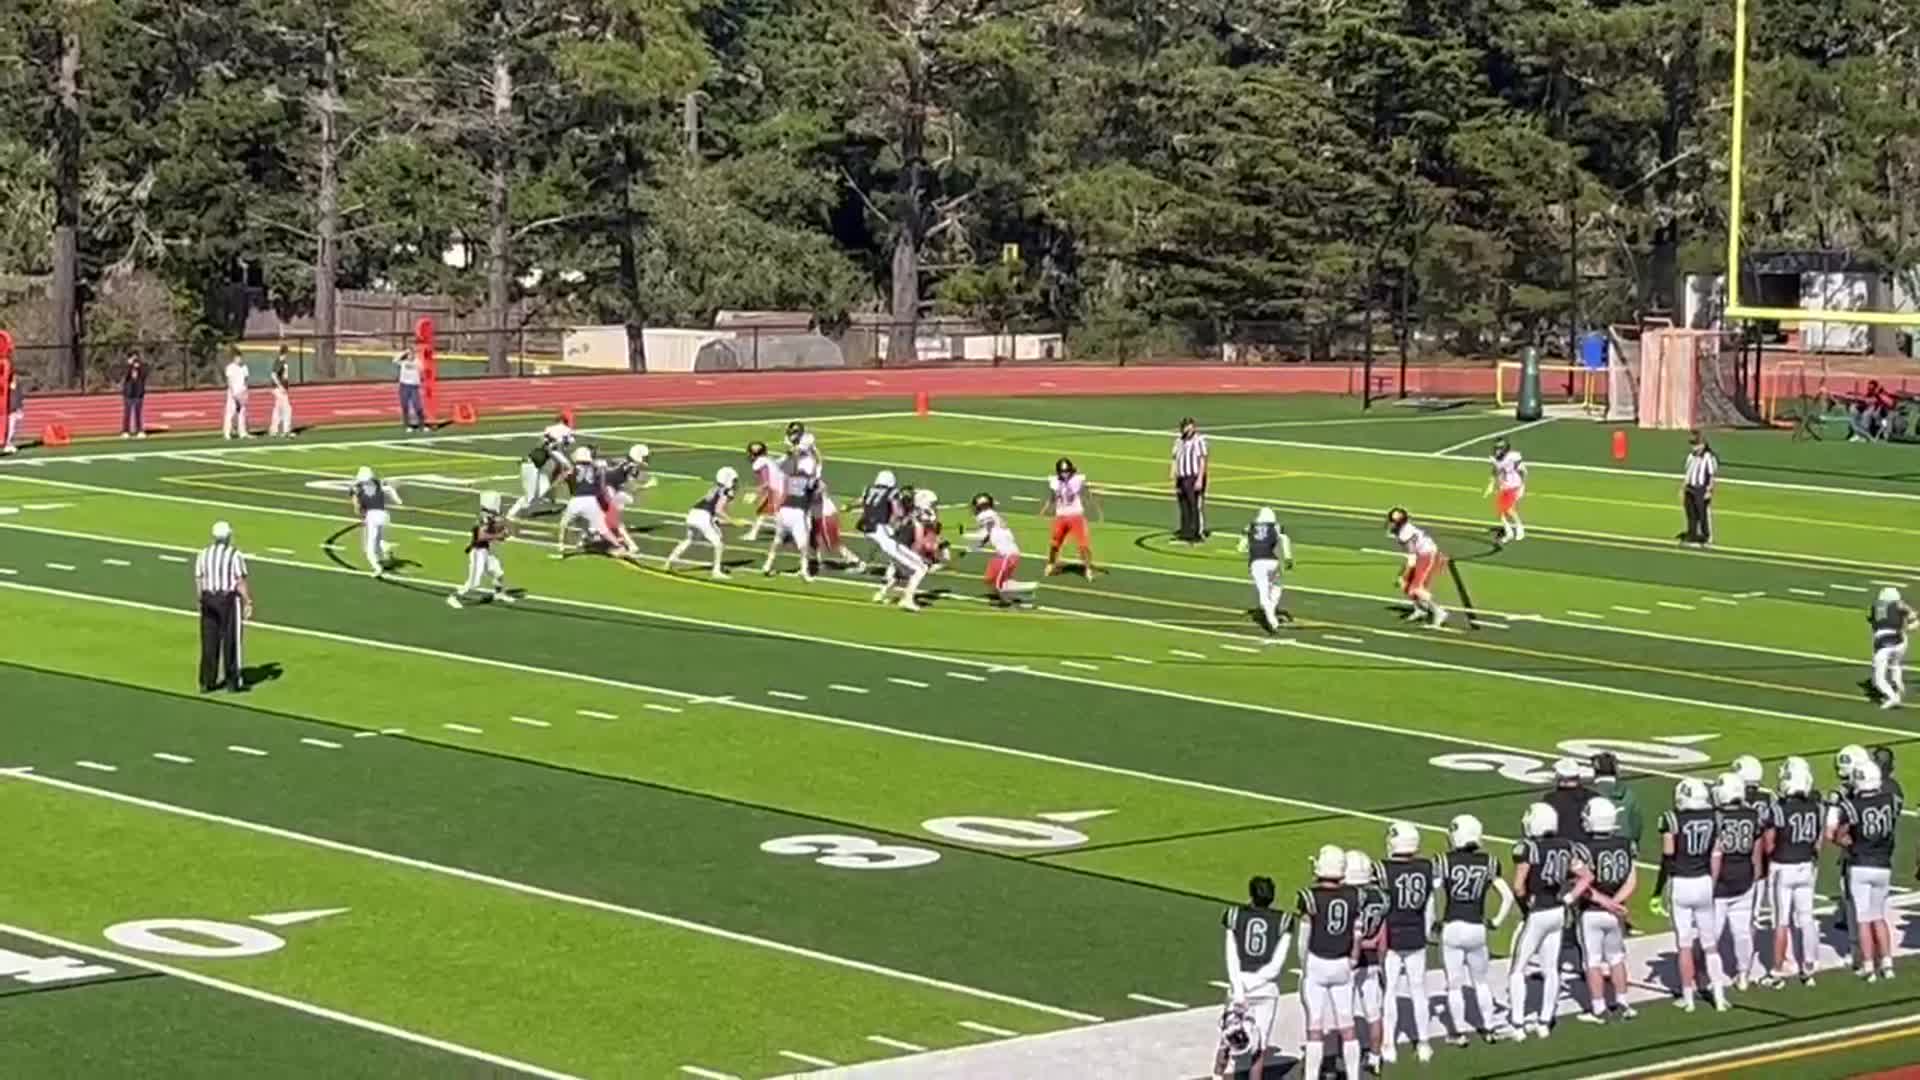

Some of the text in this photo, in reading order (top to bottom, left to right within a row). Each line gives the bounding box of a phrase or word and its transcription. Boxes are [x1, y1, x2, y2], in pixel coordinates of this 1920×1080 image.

[1429, 739, 1710, 784] 20
[1682, 819, 1713, 855] 17
[1789, 811, 1817, 843] 14
[1862, 805, 1892, 839] 81
[759, 815, 1089, 869] 30
[1395, 872, 1426, 910] 18
[1451, 864, 1488, 901] 27
[1327, 899, 1349, 935] 9
[1245, 917, 1268, 957] 6
